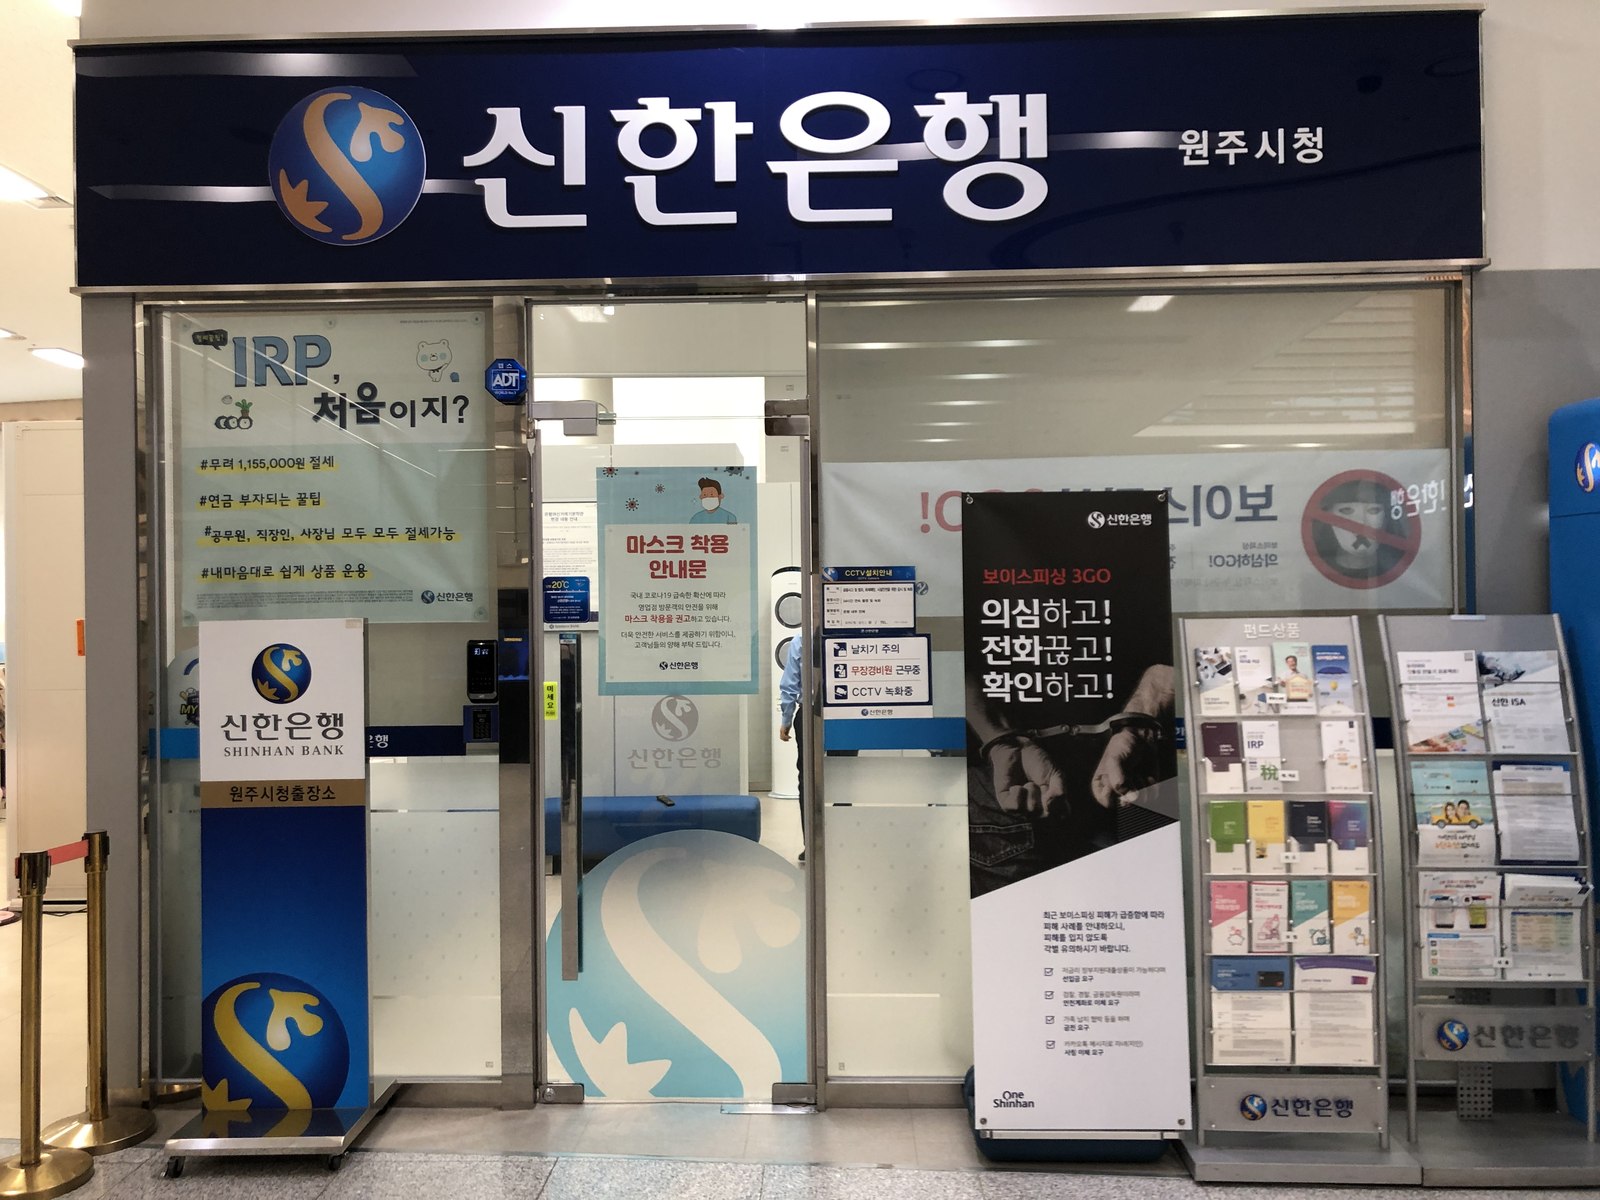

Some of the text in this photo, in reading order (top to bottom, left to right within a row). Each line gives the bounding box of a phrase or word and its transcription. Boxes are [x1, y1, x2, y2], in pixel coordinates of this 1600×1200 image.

[1178, 126, 1323, 166] 원주시청
[463, 90, 1048, 228] 신한은행
[492, 372, 519, 387] ADT
[312, 381, 470, 430] 처음이지?
[200, 455, 334, 471] #무려 1,155,000원 절세
[200, 491, 321, 508] #연금 부자되는 꿀팁
[1106, 512, 1152, 526] 신한은행
[205, 526, 456, 543] #공무원, 직장인, 사장님 모두 모두 절세가능
[626, 534, 729, 555] 마스크 착용
[201, 563, 368, 581] #내마음대로 쉽게 상품 운용
[649, 559, 707, 579] 안내문
[844, 569, 893, 577] CCTV설치안내
[982, 568, 1112, 585] 보이스피싱 3GO
[436, 591, 474, 602] 신한은행
[624, 614, 732, 623] 마스크 착용을 권고하고 있습니다.
[980, 598, 1112, 629] 의심하고!
[620, 631, 634, 639] 더욱
[635, 631, 655, 639] 안전한
[655, 631, 680, 639] 서비스를
[1243, 622, 1301, 639] 펀드상품
[634, 641, 667, 649] 고객님들의
[667, 641, 681, 649] 양해
[681, 641, 694, 649] 부탁
[851, 643, 900, 654] 날치기 주의
[981, 635, 1113, 666] 전화끊고!
[669, 661, 699, 670] 신한은행
[851, 665, 921, 676] 무장경비원 근무중
[851, 686, 914, 697] CCTV 녹화중
[982, 671, 1114, 703] 확인하고!
[546, 685, 554, 709] 미세요
[1491, 698, 1509, 707] 신한
[220, 711, 344, 741] 신한은행
[223, 745, 345, 757] SHINHAN BANK
[1247, 740, 1264, 749] IRP
[627, 747, 722, 770] 신한은행
[229, 785, 337, 803] 원주시청출장소
[1043, 911, 1058, 919] 최근
[1059, 911, 1095, 919] 보이스피싱
[1096, 911, 1118, 919] 피해가
[1149, 911, 1165, 919] 따라
[1043, 922, 1126, 931] 피해 사례를 안내하오니,
[1044, 933, 1108, 942] 피해를 입지 않도록
[1044, 945, 1131, 953] 각별 유의하시기 바랍니다.
[1473, 1024, 1580, 1049] 신한은행
[1002, 1090, 1025, 1100] One
[992, 1098, 1035, 1108] Shinhan
[1270, 1097, 1354, 1119] 신한은행
